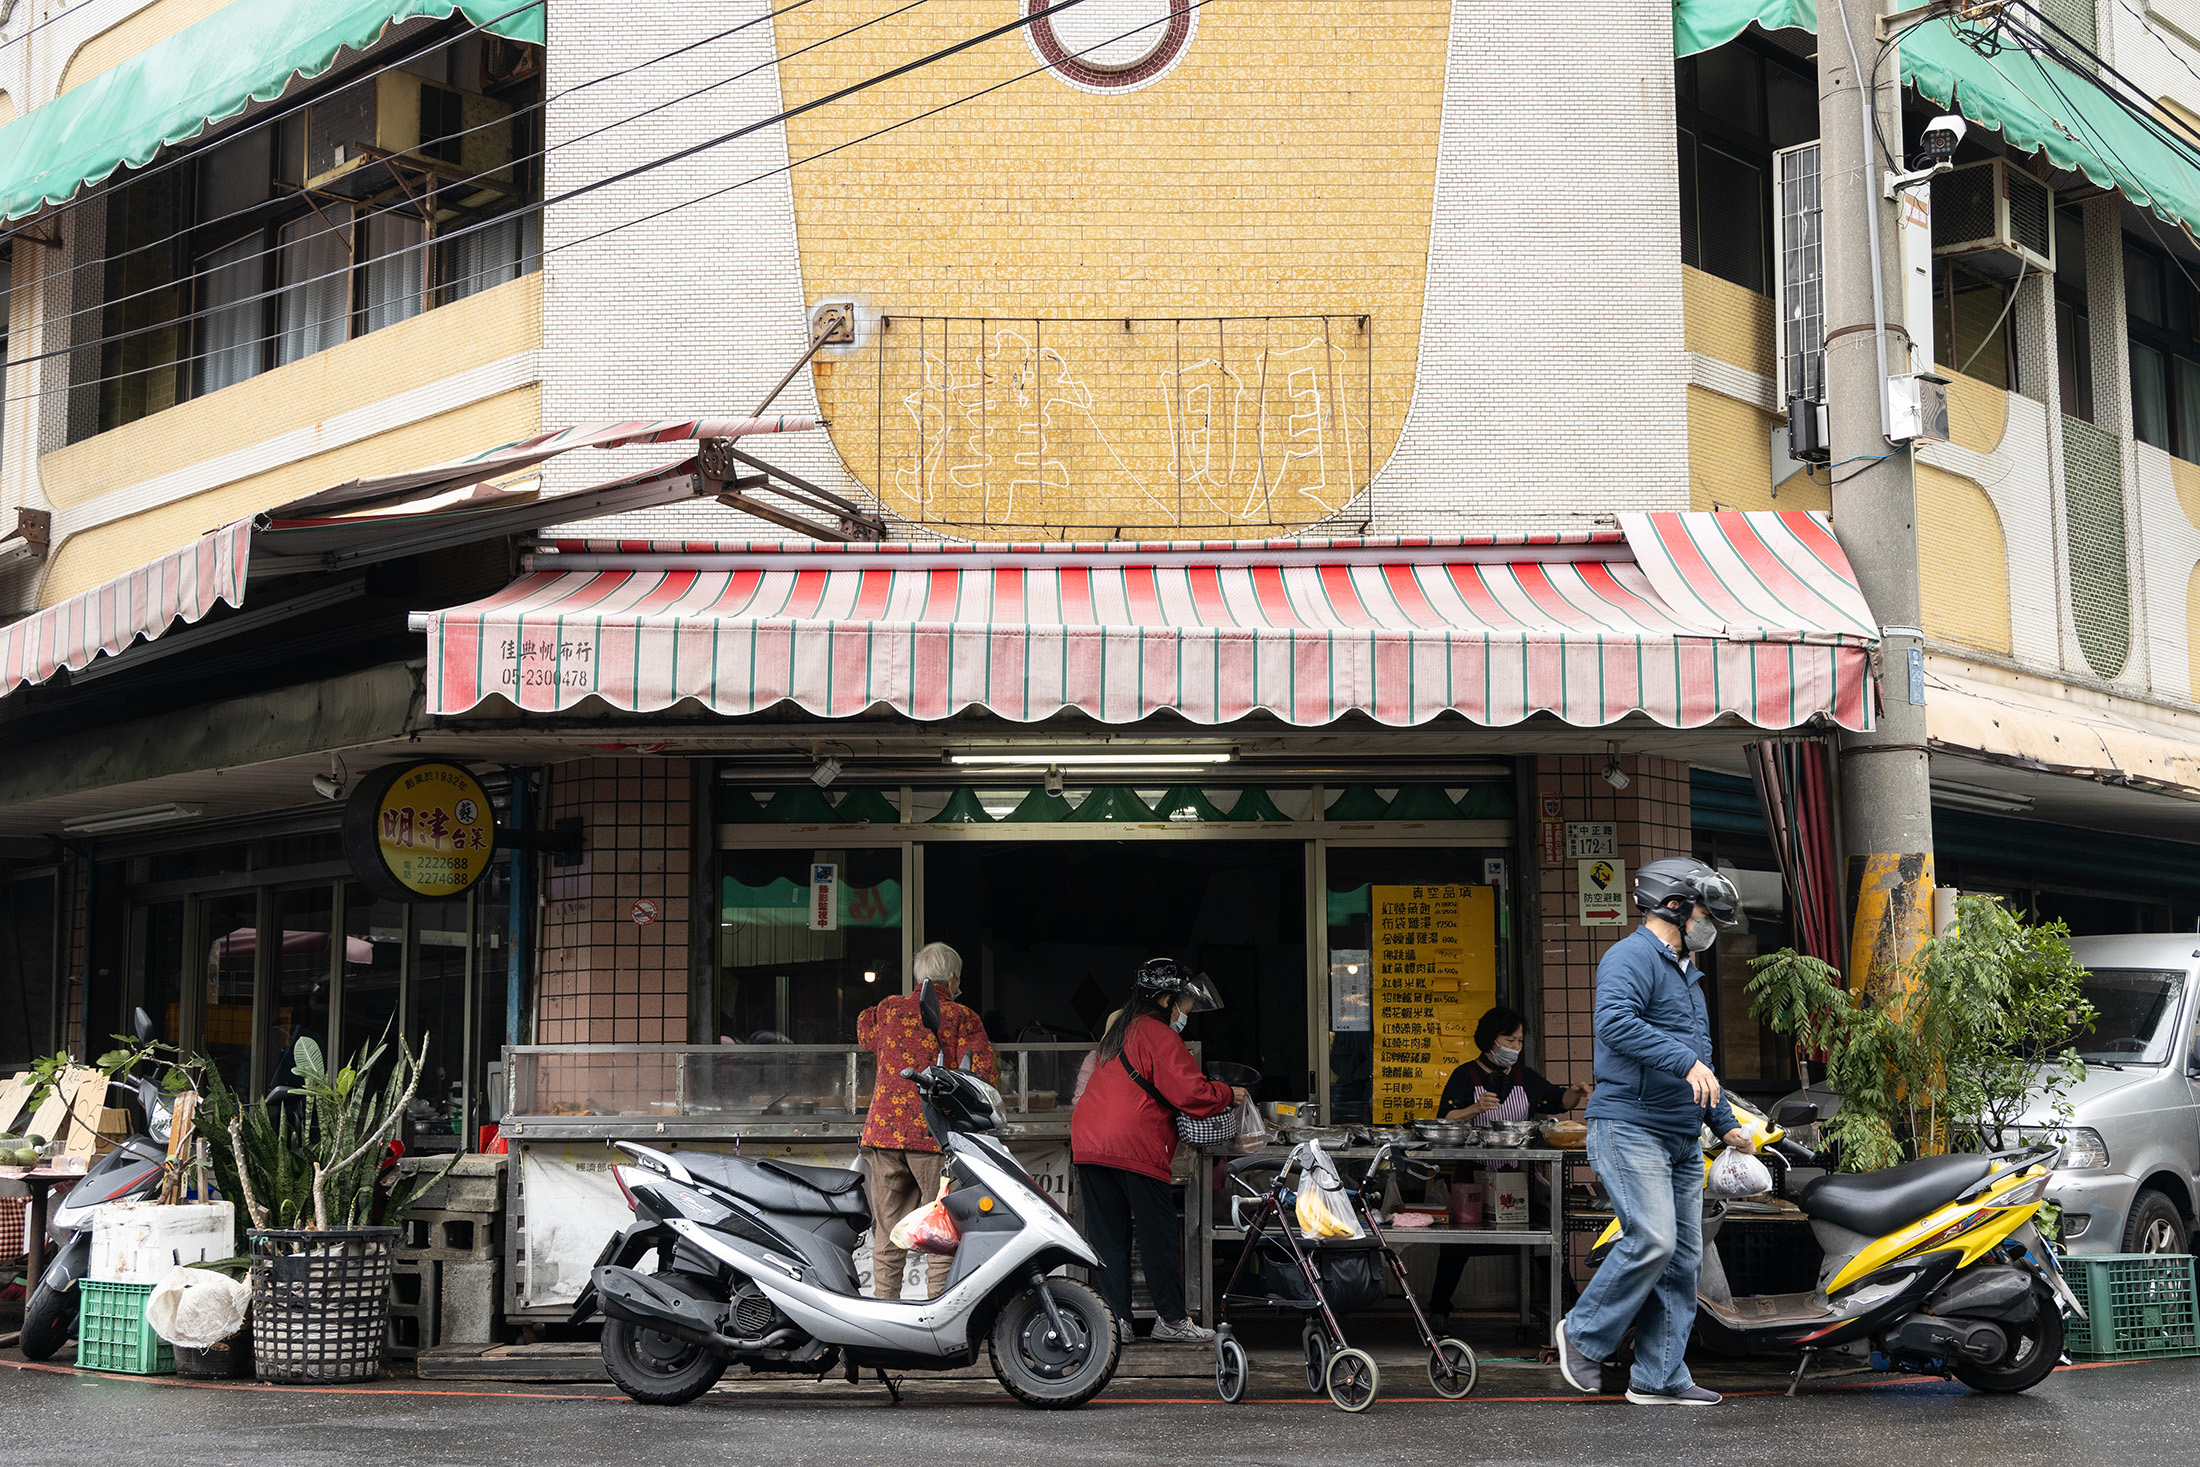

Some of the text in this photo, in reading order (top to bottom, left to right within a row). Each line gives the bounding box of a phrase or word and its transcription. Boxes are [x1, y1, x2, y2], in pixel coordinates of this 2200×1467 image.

[501, 640, 592, 662] 佳典帆布行
[502, 669, 587, 686] 05-2300478
[405, 771, 468, 792] 創業於1932年
[382, 806, 488, 851] 明津 台菜
[1580, 826, 1613, 836] 中正路
[1580, 839, 1613, 854] 172之1
[417, 857, 468, 869] 2222688
[417, 873, 468, 885] 2274688
[1584, 893, 1622, 903] 防空避難
[818, 885, 829, 928] 錄影監視中
[1382, 902, 1431, 915] 紅燒魚翅
[1382, 916, 1431, 929] 布袋雞湯
[1382, 1037, 1431, 1049] 紅燒牛肉湯
[1383, 1097, 1433, 1109] 白菜獅子頭
